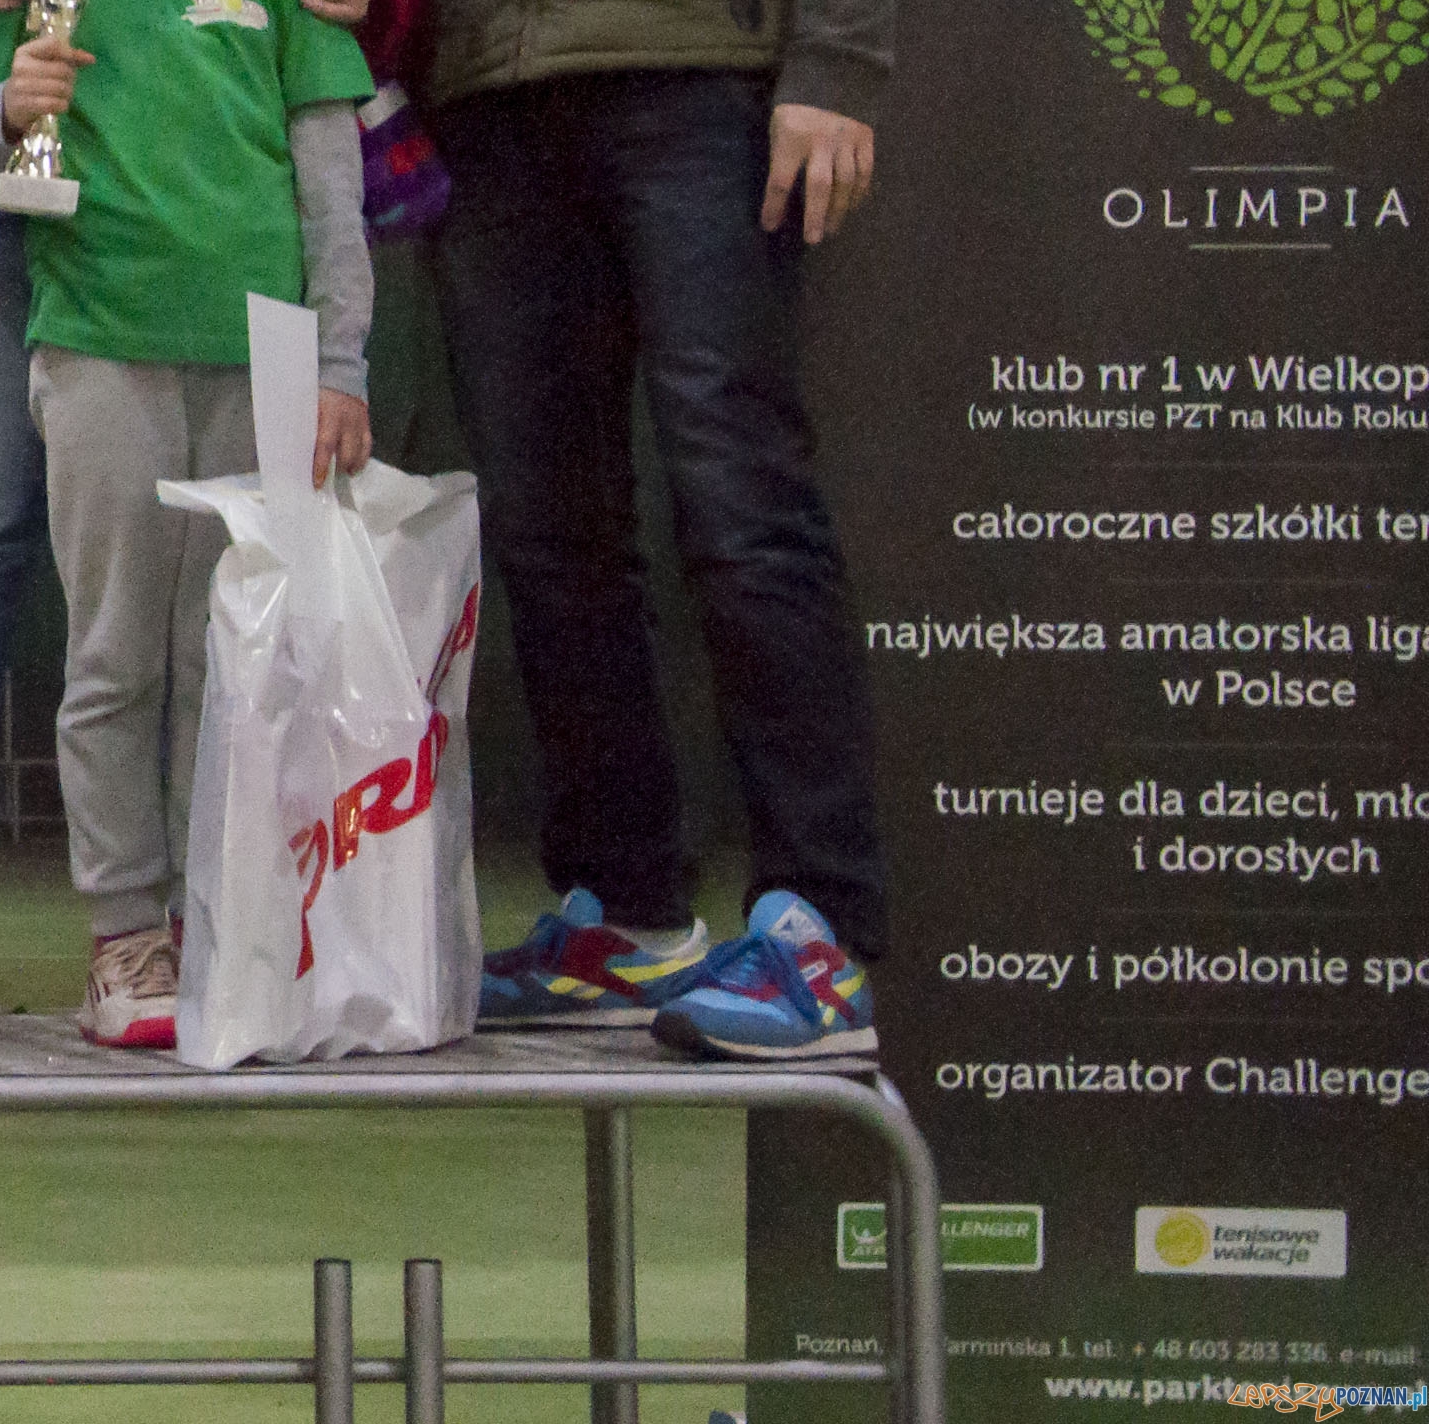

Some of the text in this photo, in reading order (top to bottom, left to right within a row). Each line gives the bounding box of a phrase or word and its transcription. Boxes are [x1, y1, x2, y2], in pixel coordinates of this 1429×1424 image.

[1103, 187, 1409, 229] OLIMPIA
[992, 356, 1429, 400] klub nr 1 w Wielkop
[968, 404, 1428, 431] (w konkursie PZT na Klub Roku
[953, 504, 1197, 541] całoroczne
[1210, 504, 1362, 541] szkółki
[866, 615, 1106, 659] największa
[1120, 616, 1352, 653] amatorska
[1162, 671, 1357, 708] w Polsce
[933, 781, 1105, 825] turnieje
[1119, 781, 1185, 818] dla
[1198, 781, 1338, 821] dzieci,
[1133, 837, 1380, 880] i dorosłych
[941, 945, 1073, 988] obozy
[1087, 947, 1099, 980] i
[1113, 947, 1349, 990] półkolonie
[936, 1058, 1192, 1098] organizator
[1213, 1224, 1320, 1246] tenisowe
[1213, 1244, 1311, 1266] wakacje
[945, 1336, 1051, 1356] armińska
[1153, 1339, 1182, 1360] 48
[1189, 1340, 1230, 1361] 603
